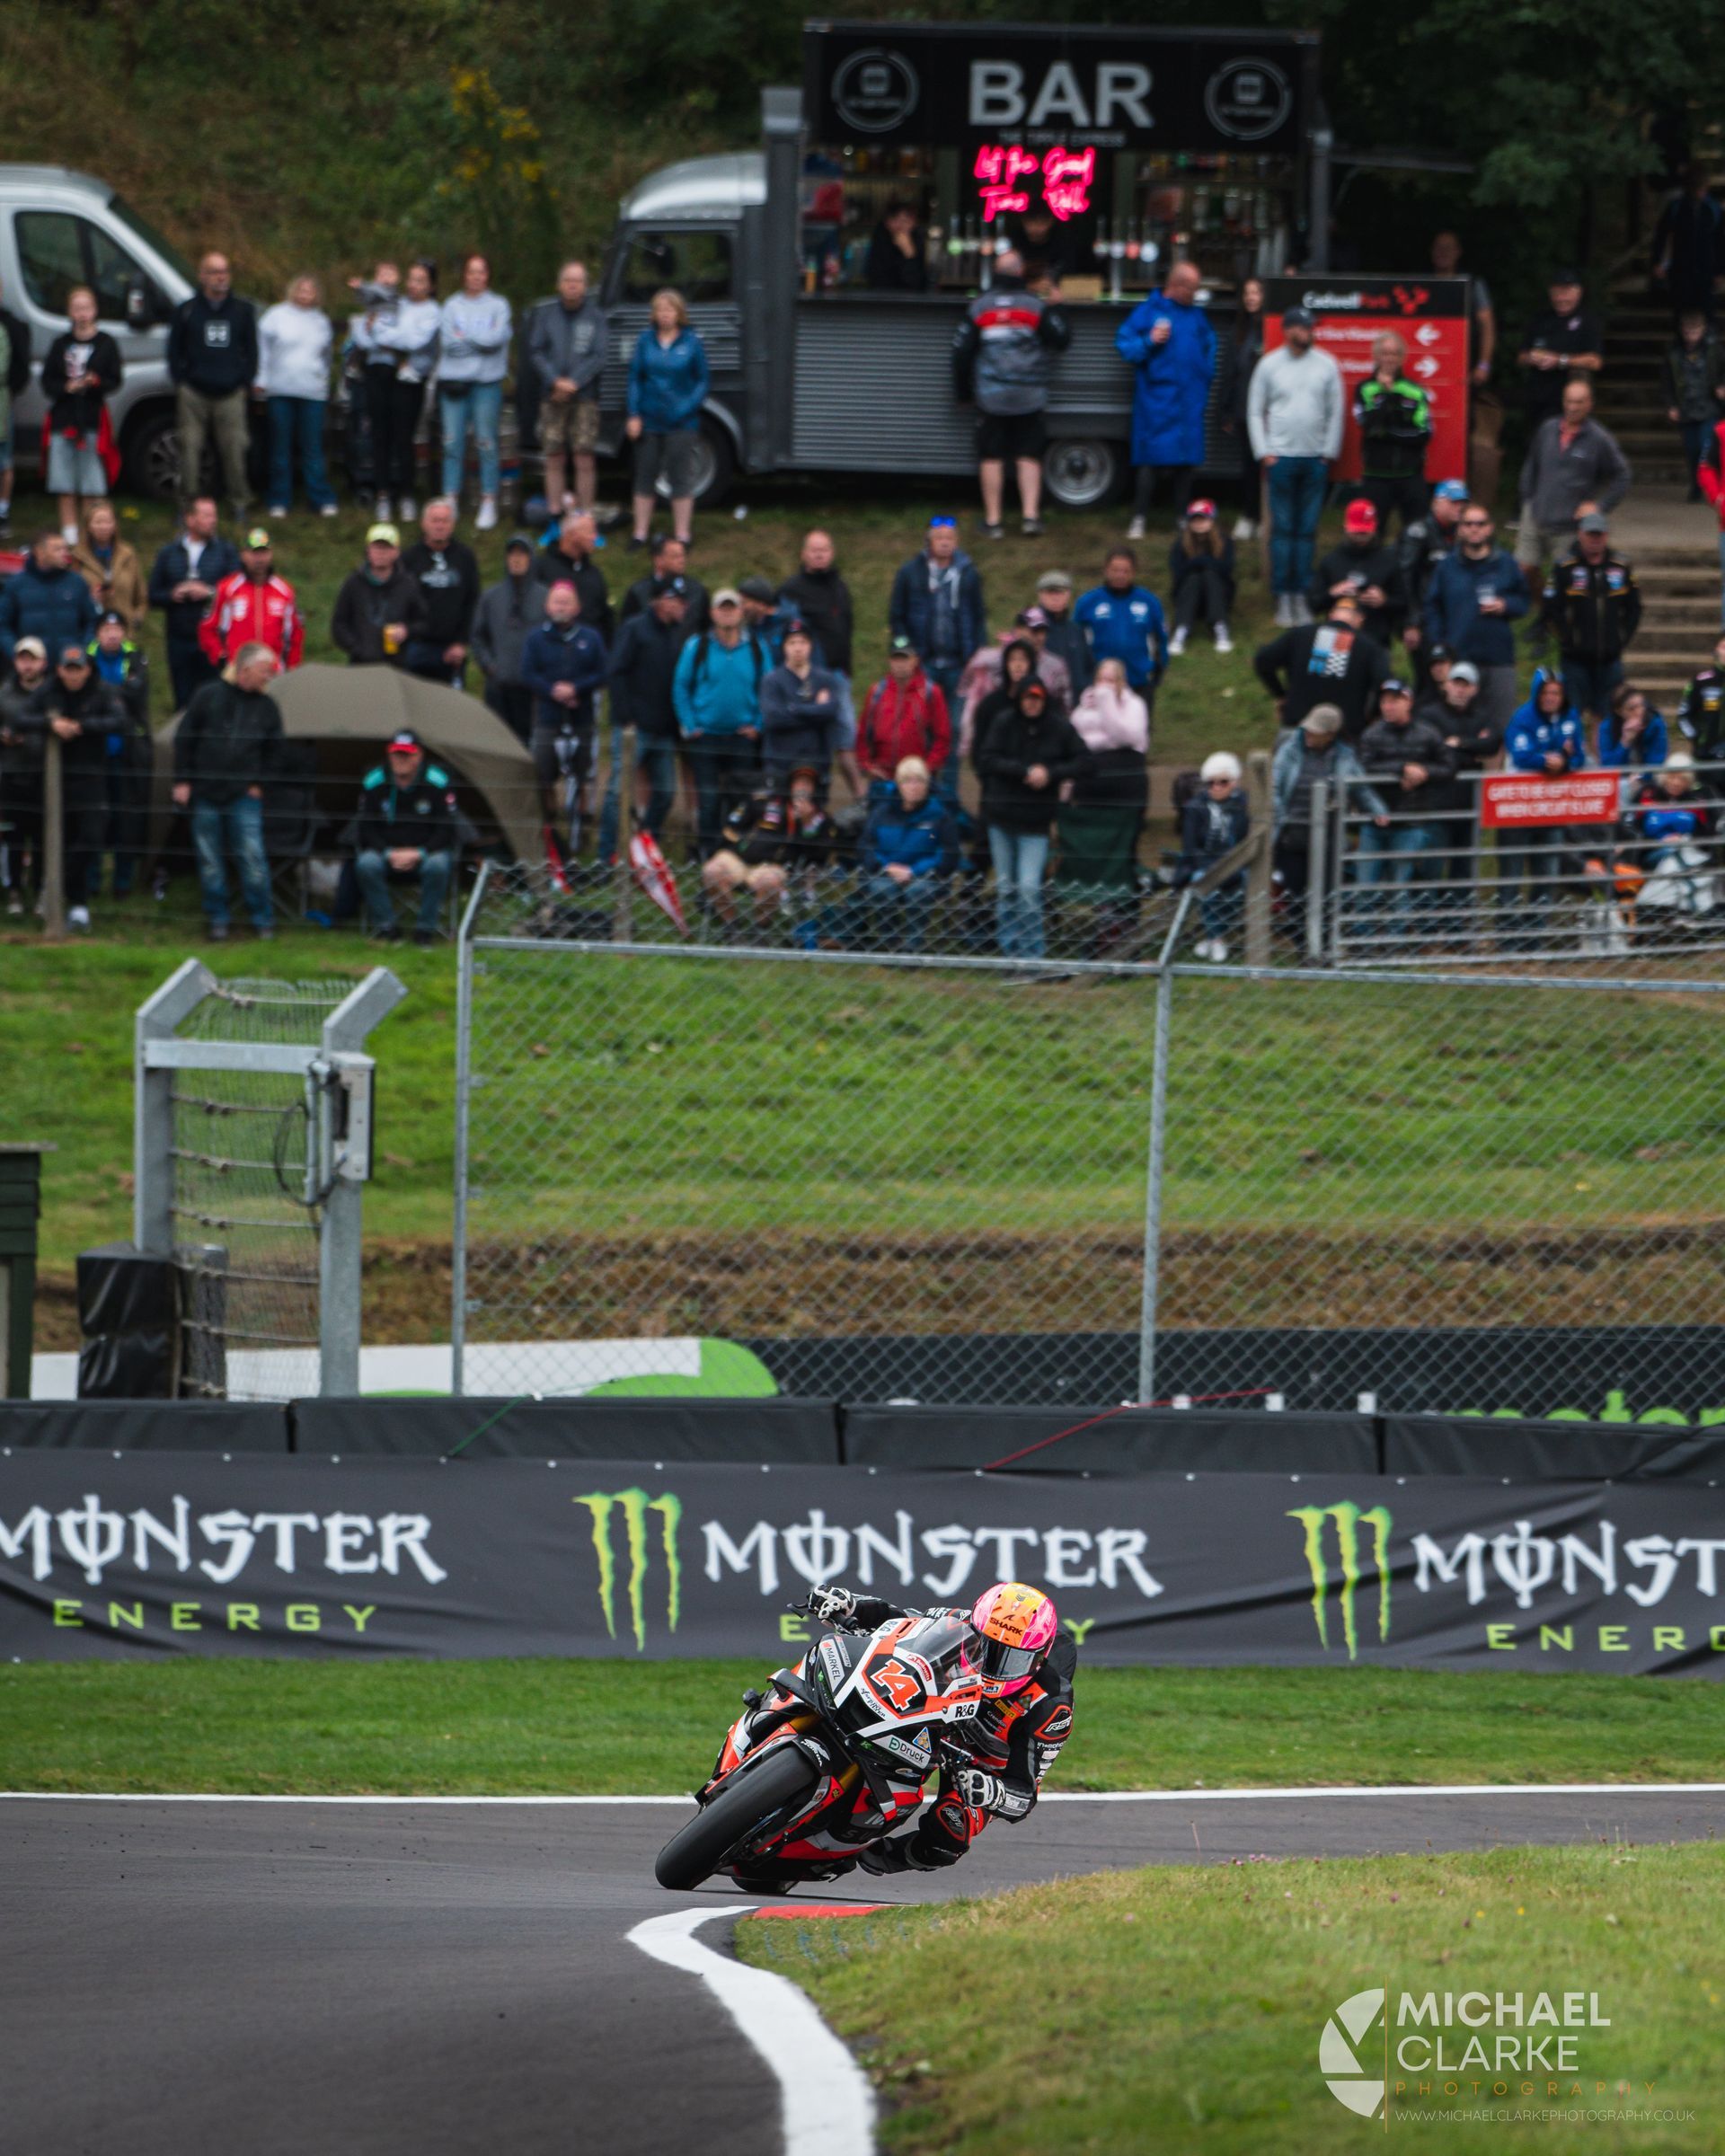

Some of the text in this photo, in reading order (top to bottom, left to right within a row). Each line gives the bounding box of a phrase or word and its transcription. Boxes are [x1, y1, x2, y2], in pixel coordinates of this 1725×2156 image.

[969, 59, 1154, 128] BAR
[0, 1494, 447, 1585] MONSTER
[701, 1508, 1164, 1597] MONSTER
[52, 1598, 376, 1632] ENERGY
[989, 1616, 1023, 1636] SHARK
[825, 1647, 842, 1681] MARKEL
[870, 1658, 922, 1711] 14
[954, 1703, 976, 1719] R&G
[899, 1743, 924, 1763] Druck
